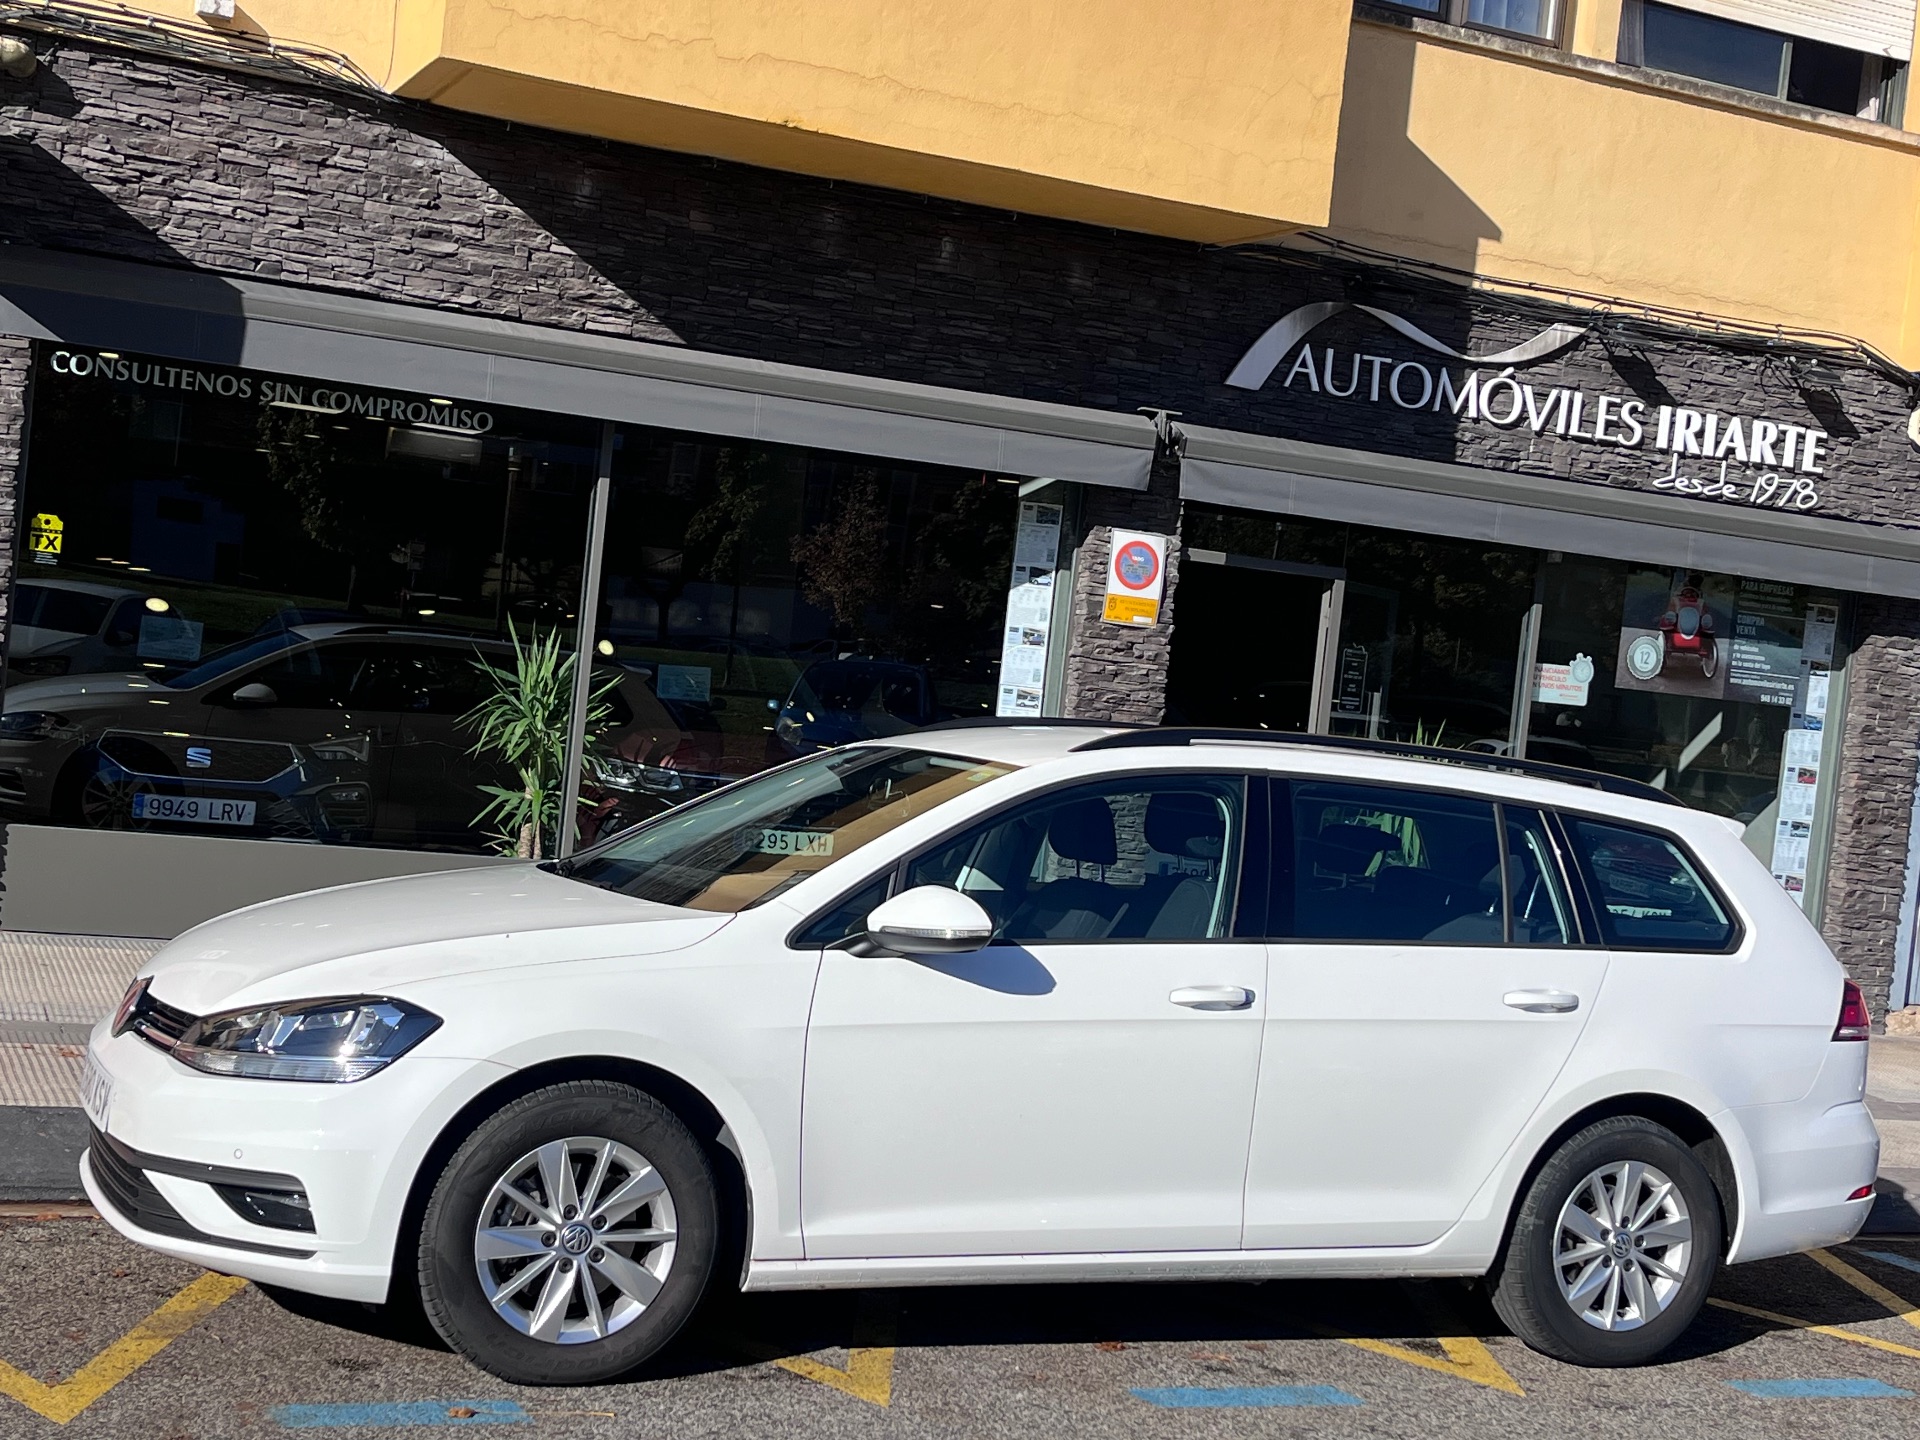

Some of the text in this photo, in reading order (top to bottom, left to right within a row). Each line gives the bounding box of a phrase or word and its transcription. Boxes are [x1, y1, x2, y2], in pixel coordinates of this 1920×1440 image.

[51, 350, 494, 432] CONSULTENOS SIN COMPROMISO
[1283, 343, 1828, 477] AUTOMÓVILES IRIARTE
[1653, 452, 1819, 510] desde 1978
[32, 534, 58, 551] TX
[1737, 614, 1765, 626] COMPRA
[1736, 625, 1757, 636] VENTA
[1640, 650, 1650, 665] 12
[1534, 666, 1571, 675] NANCIAMOS
[148, 798, 246, 823] 9949 LRV
[795, 835, 827, 853] LXH
